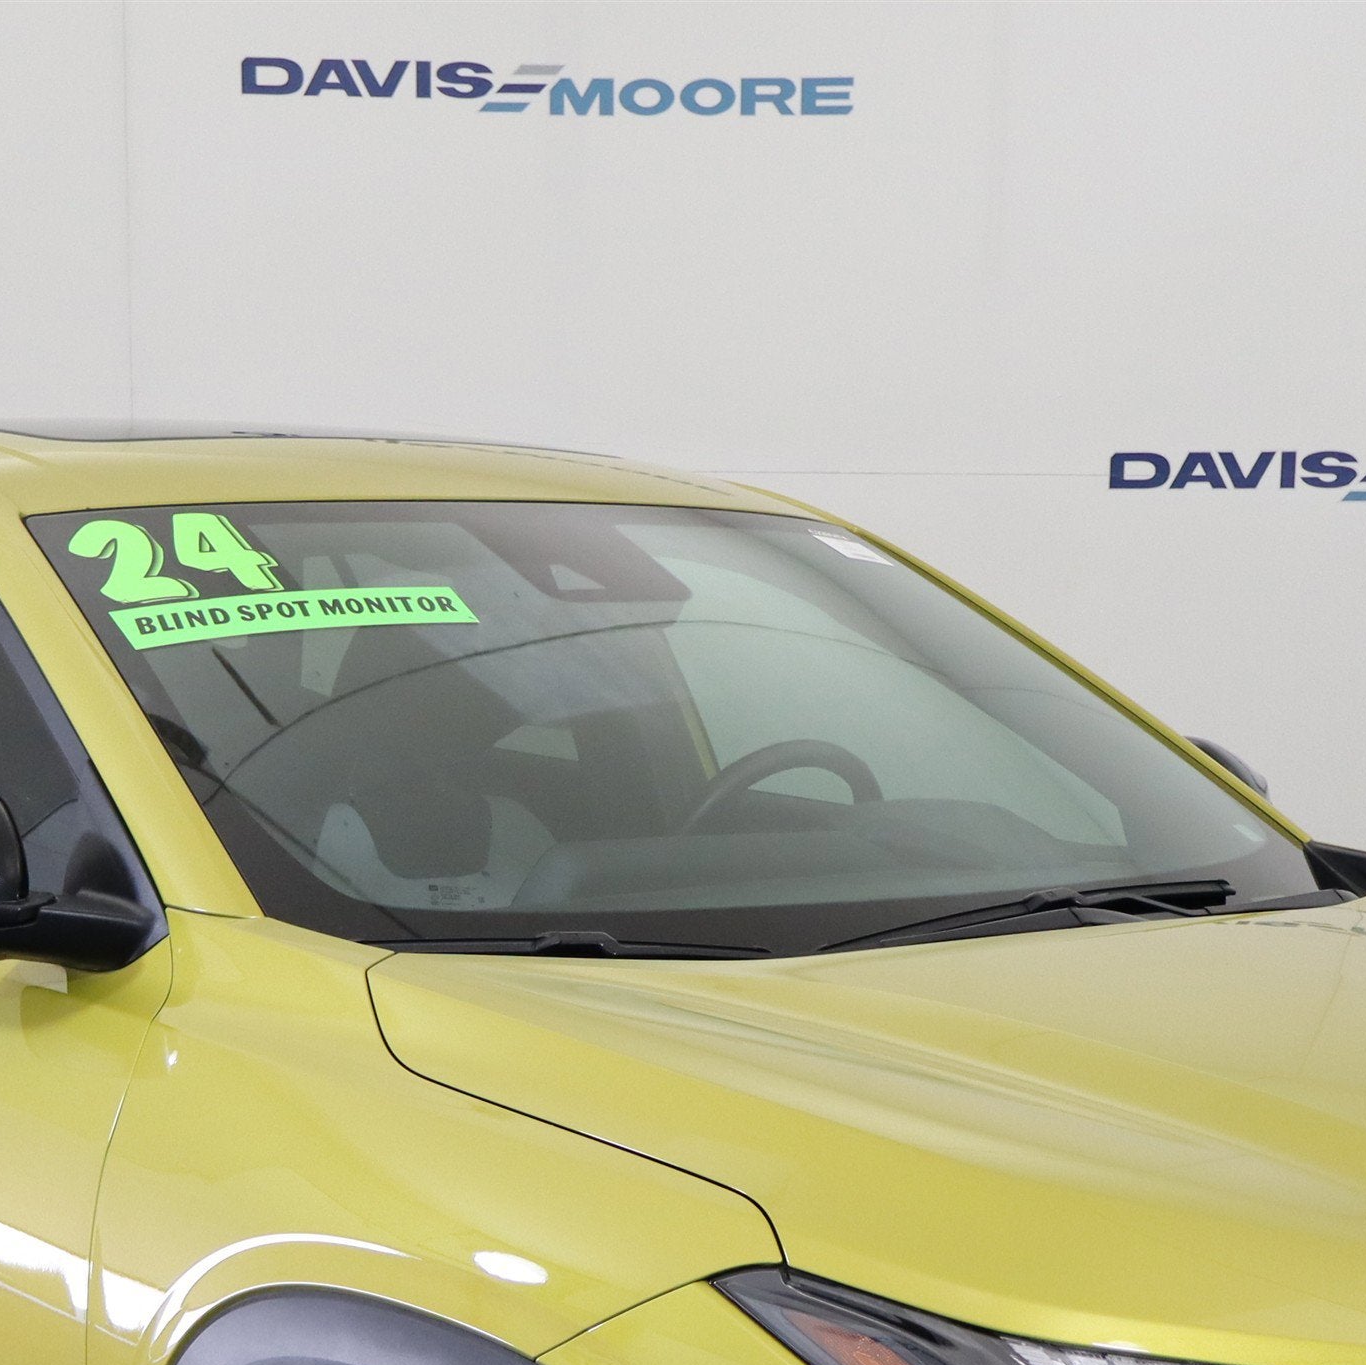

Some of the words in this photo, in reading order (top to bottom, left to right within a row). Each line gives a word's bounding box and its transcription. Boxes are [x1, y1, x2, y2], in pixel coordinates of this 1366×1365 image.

[240, 56, 493, 97] DAVIS
[549, 76, 853, 116] MOORE
[1109, 451, 1358, 489] DAVIS
[68, 512, 285, 603] 24
[135, 607, 231, 634] BLIND
[241, 600, 309, 622] SPOT
[320, 596, 457, 617] MONITOR
